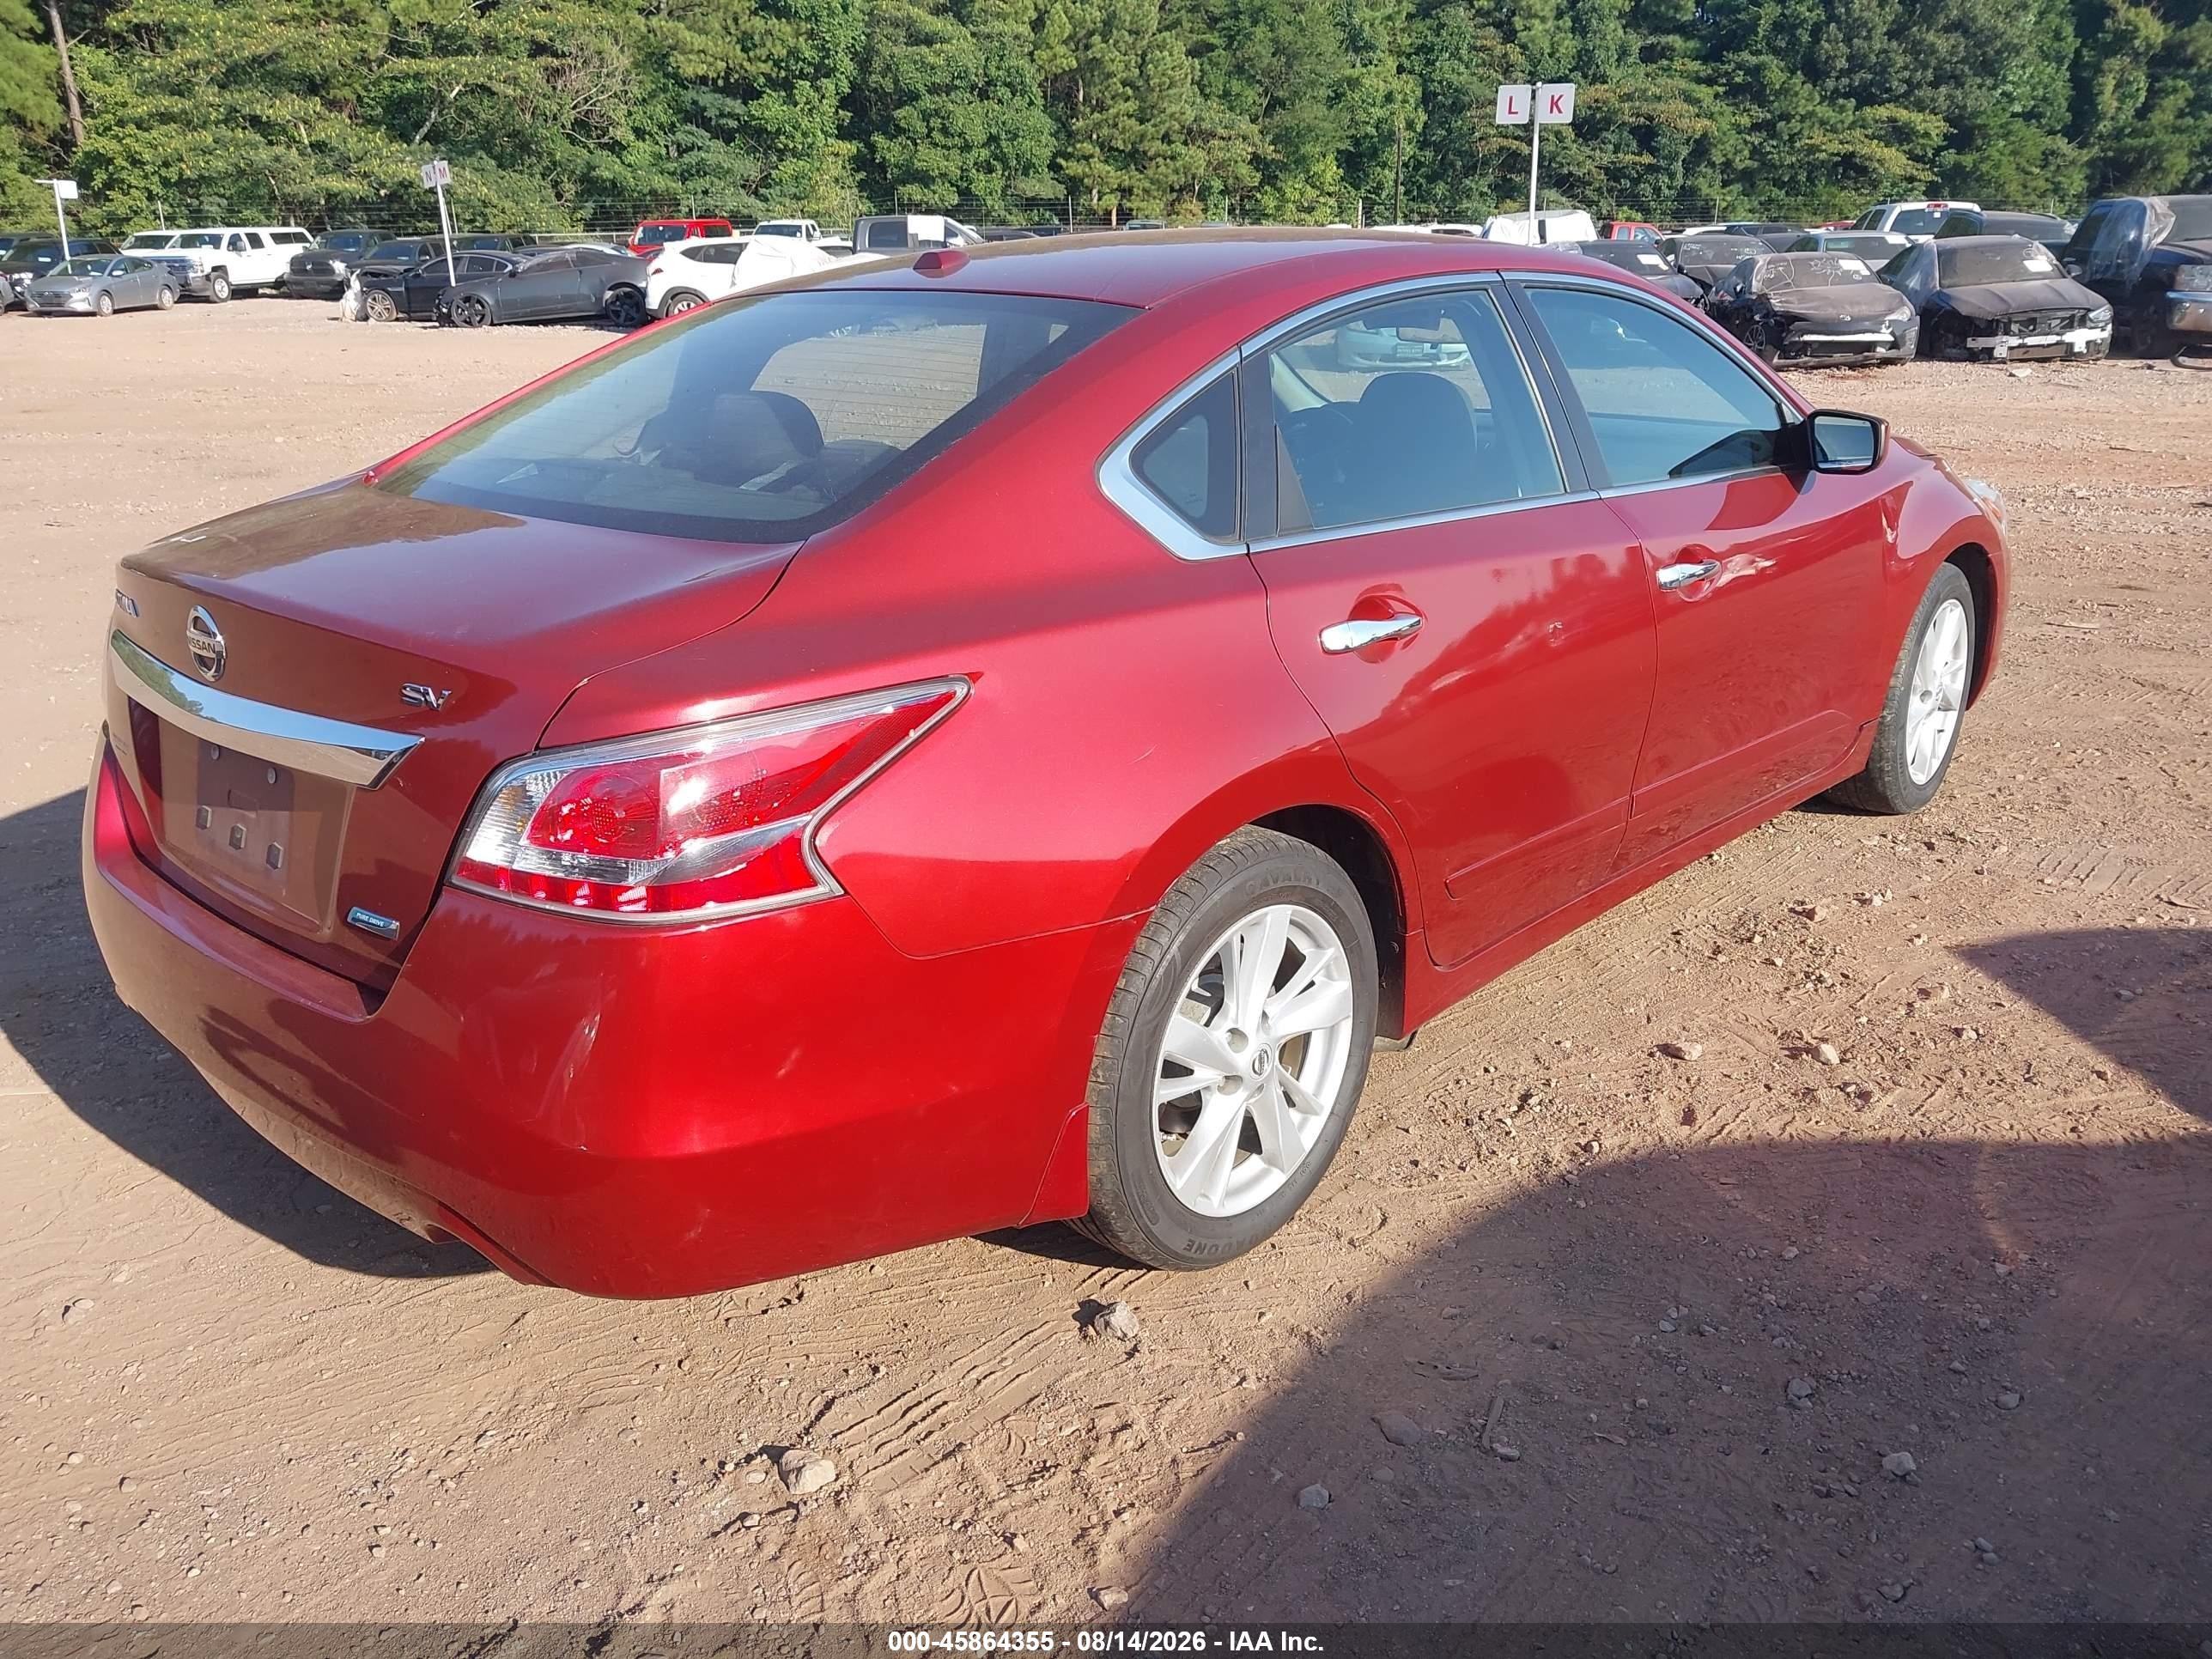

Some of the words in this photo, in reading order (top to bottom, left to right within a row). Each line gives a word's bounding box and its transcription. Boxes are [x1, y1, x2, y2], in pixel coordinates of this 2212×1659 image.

[1507, 95, 1519, 115] L
[1548, 94, 1565, 114] K
[425, 171, 432, 182] N
[438, 167, 447, 179] M
[400, 683, 453, 711] SV
[368, 916, 385, 927] DRIVE
